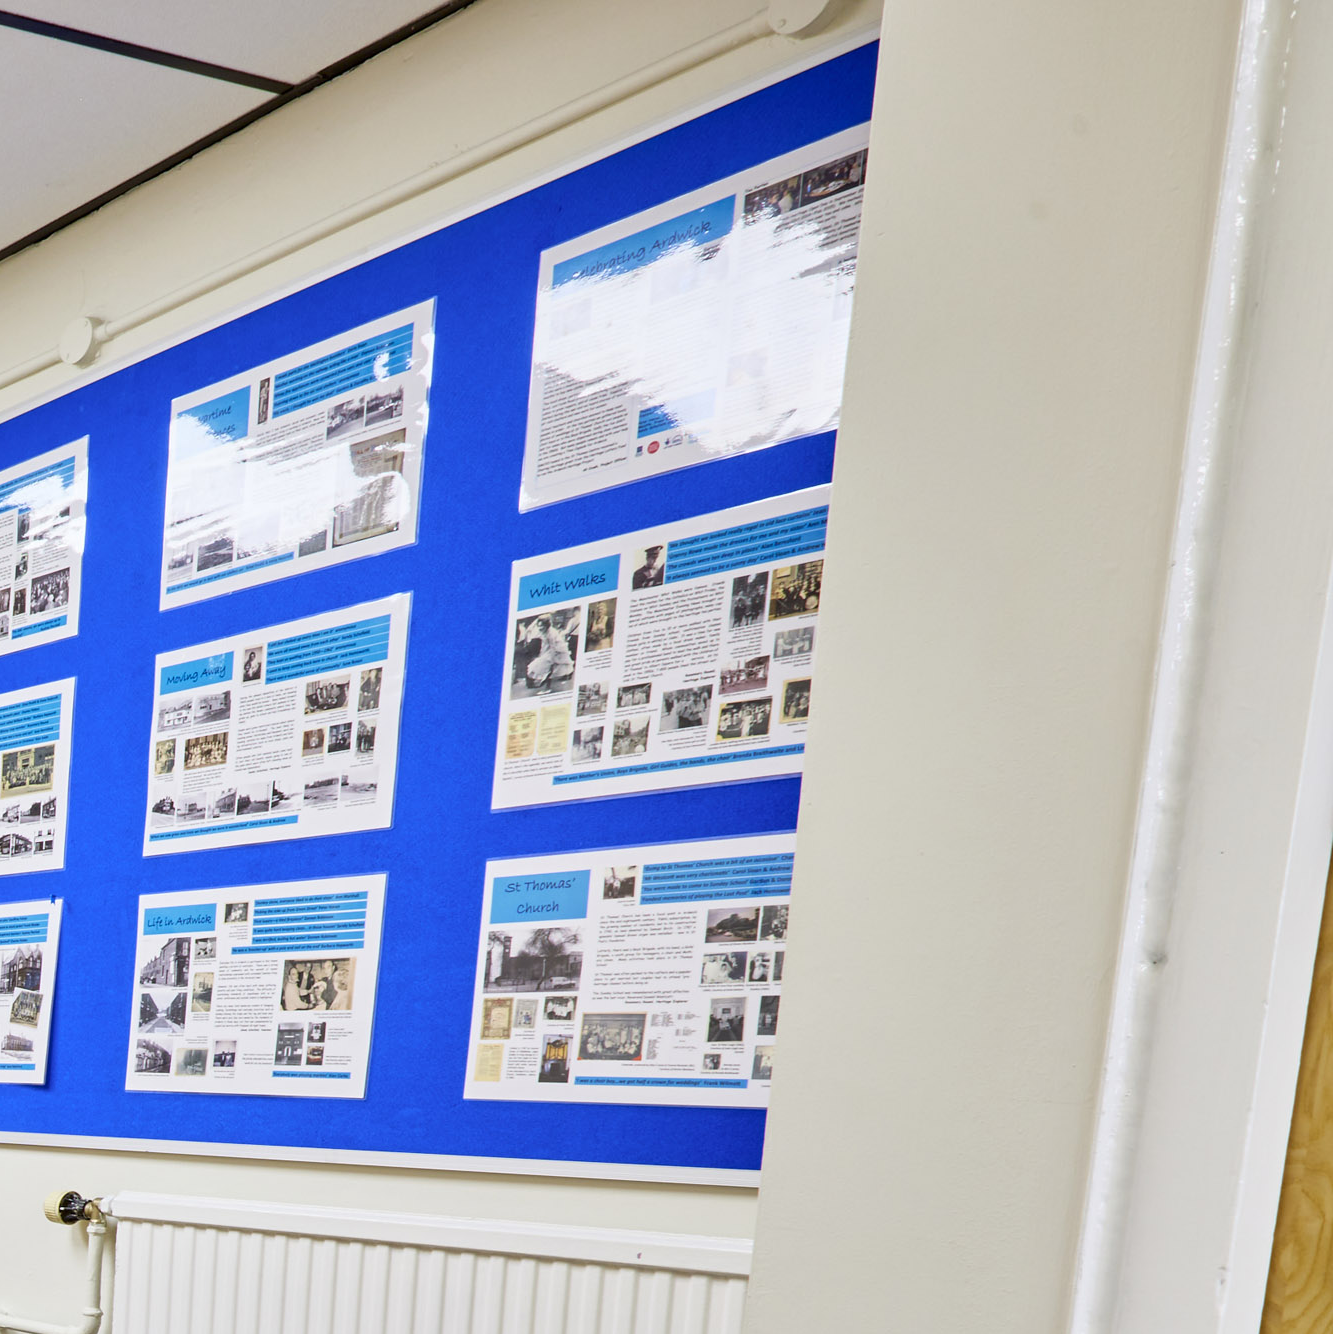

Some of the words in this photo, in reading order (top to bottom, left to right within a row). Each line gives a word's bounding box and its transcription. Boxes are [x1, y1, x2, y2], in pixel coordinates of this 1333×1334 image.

[650, 220, 712, 253] Ardwick
[530, 582, 561, 598] Whit
[564, 573, 606, 591] Walks
[166, 671, 199, 685] Moving
[200, 666, 226, 678] Away
[505, 882, 521, 893] St
[516, 900, 559, 913] Church
[147, 916, 162, 931] Life
[165, 917, 173, 926] in
[175, 914, 212, 926] Ardwick
